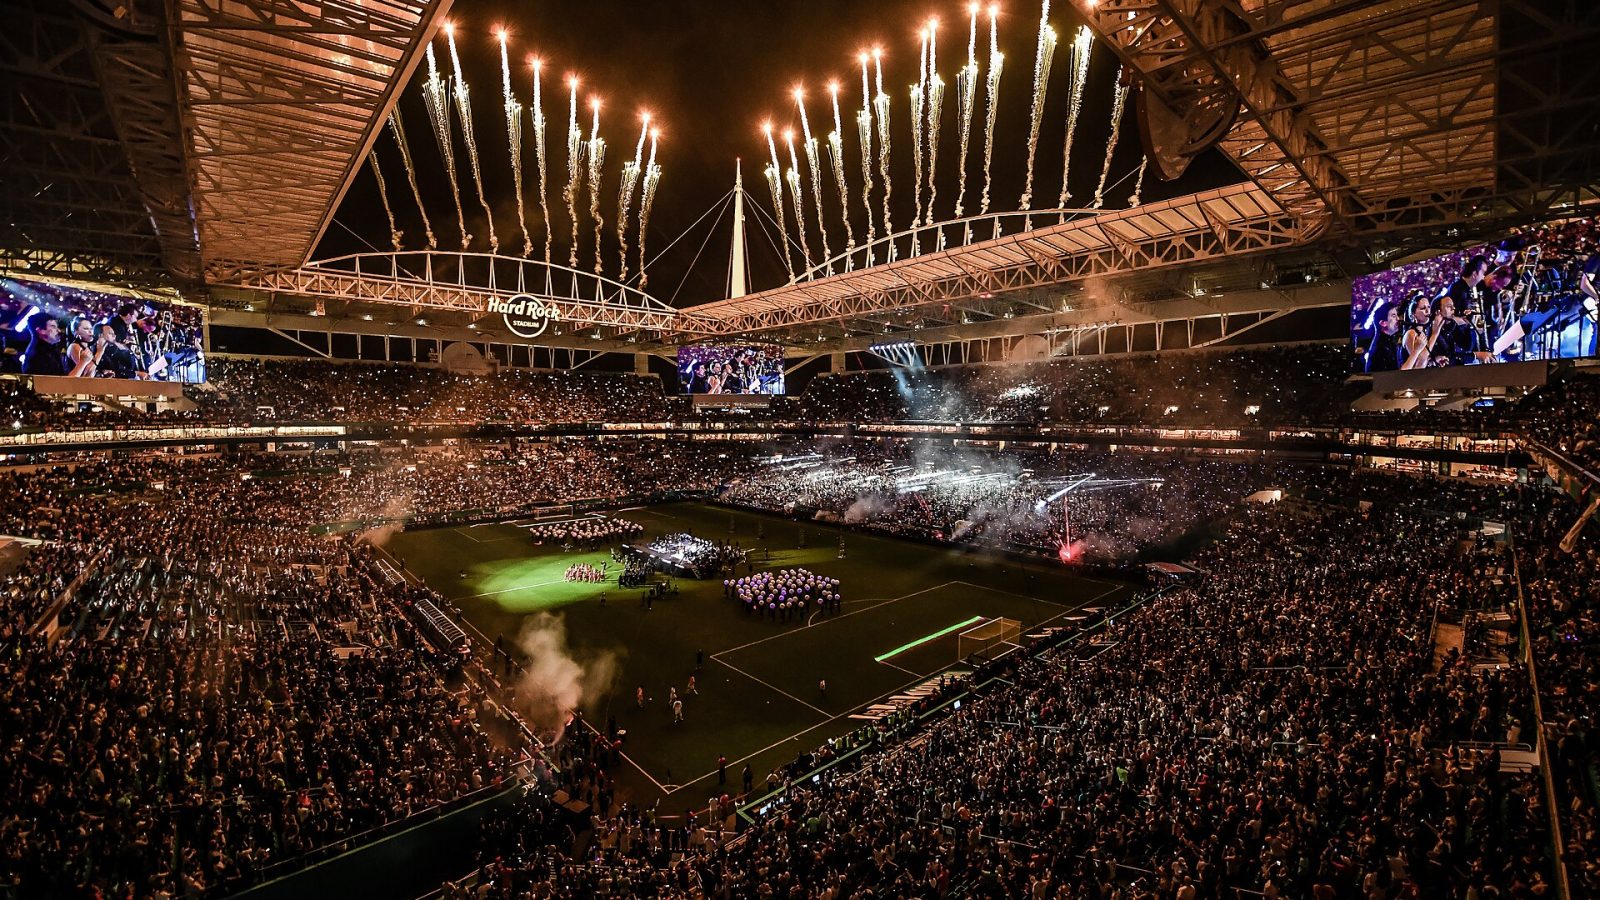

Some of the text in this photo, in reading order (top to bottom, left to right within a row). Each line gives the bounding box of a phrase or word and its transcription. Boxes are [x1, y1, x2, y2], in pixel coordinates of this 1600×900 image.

[487, 295, 560, 322] Hard Rock
[512, 320, 540, 328] STADIUM
